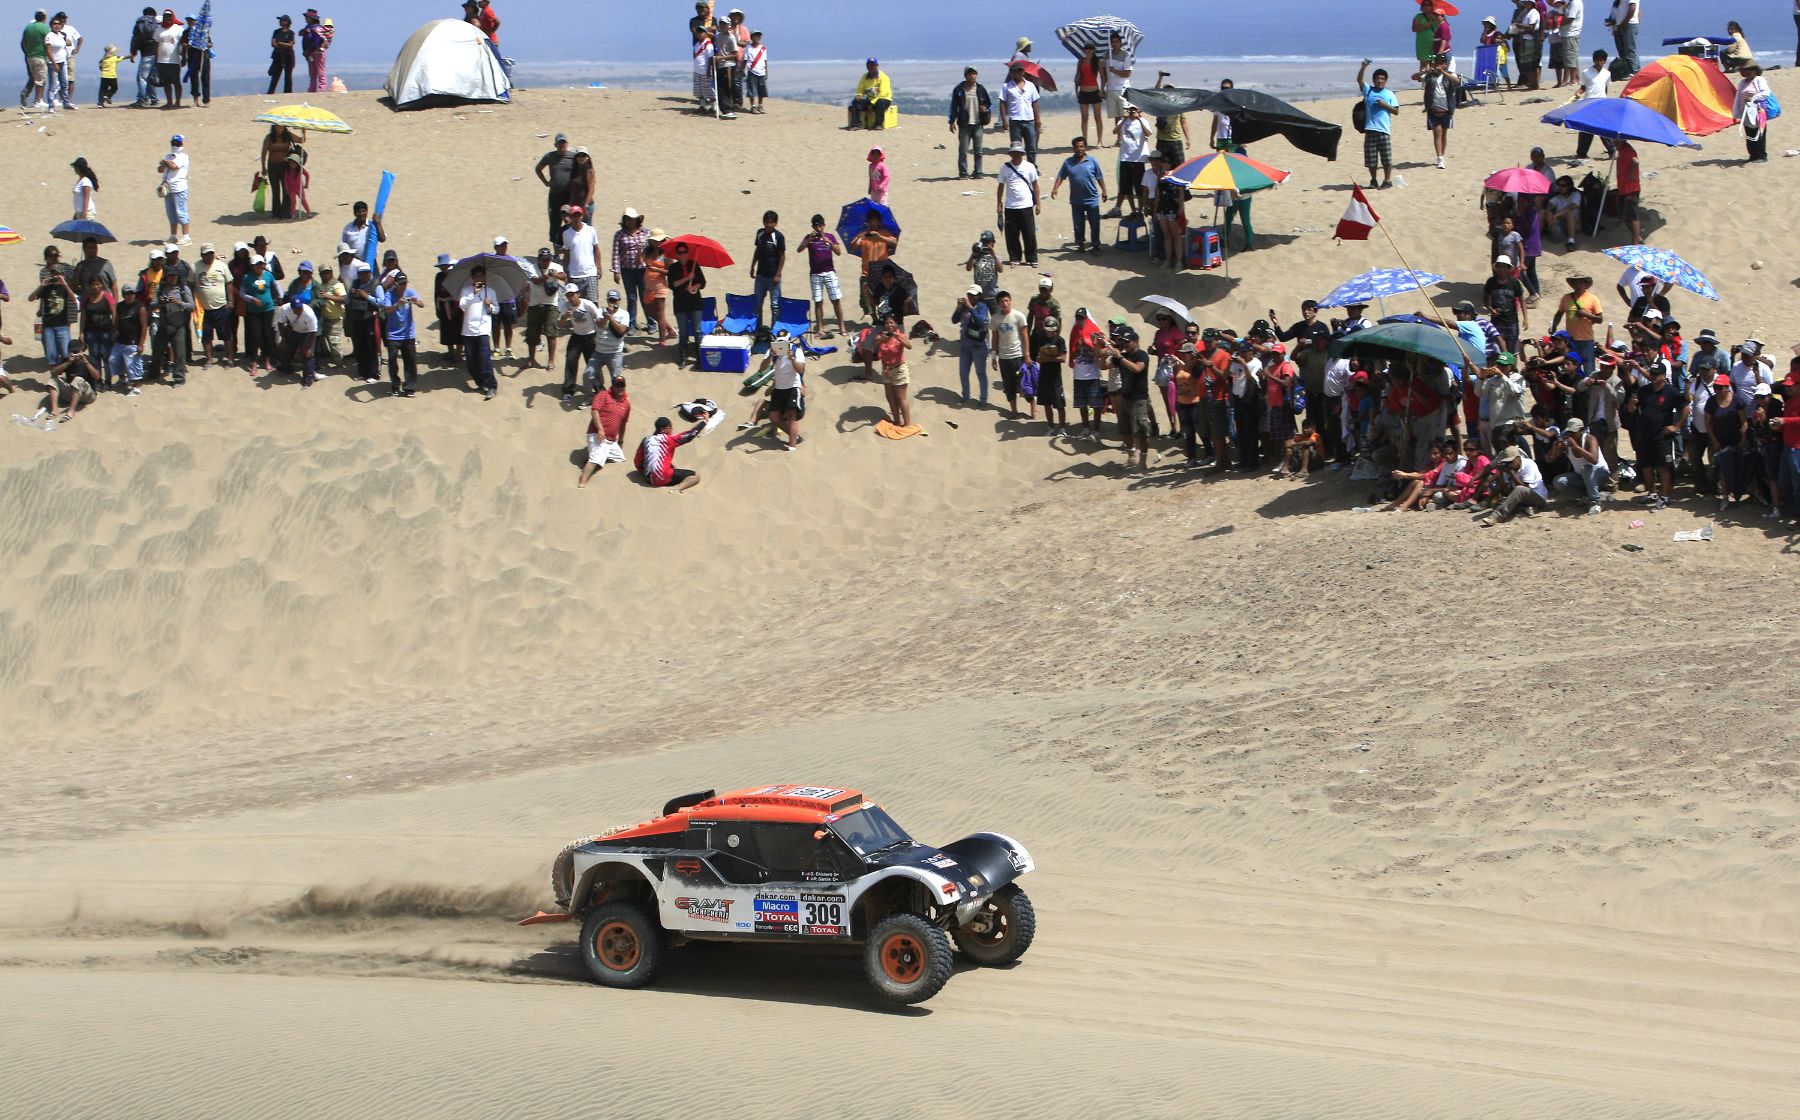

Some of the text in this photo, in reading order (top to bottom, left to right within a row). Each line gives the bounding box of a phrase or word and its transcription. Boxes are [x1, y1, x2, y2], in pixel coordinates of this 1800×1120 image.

[732, 797, 759, 805] CATCH
[781, 797, 799, 807] YOU
[755, 892, 796, 901] dakar.com
[802, 894, 843, 903] dakar.com
[762, 901, 790, 911] Macro
[764, 912, 798, 922] TOTAL
[805, 903, 841, 925] 309
[812, 926, 838, 934] TOTAL
